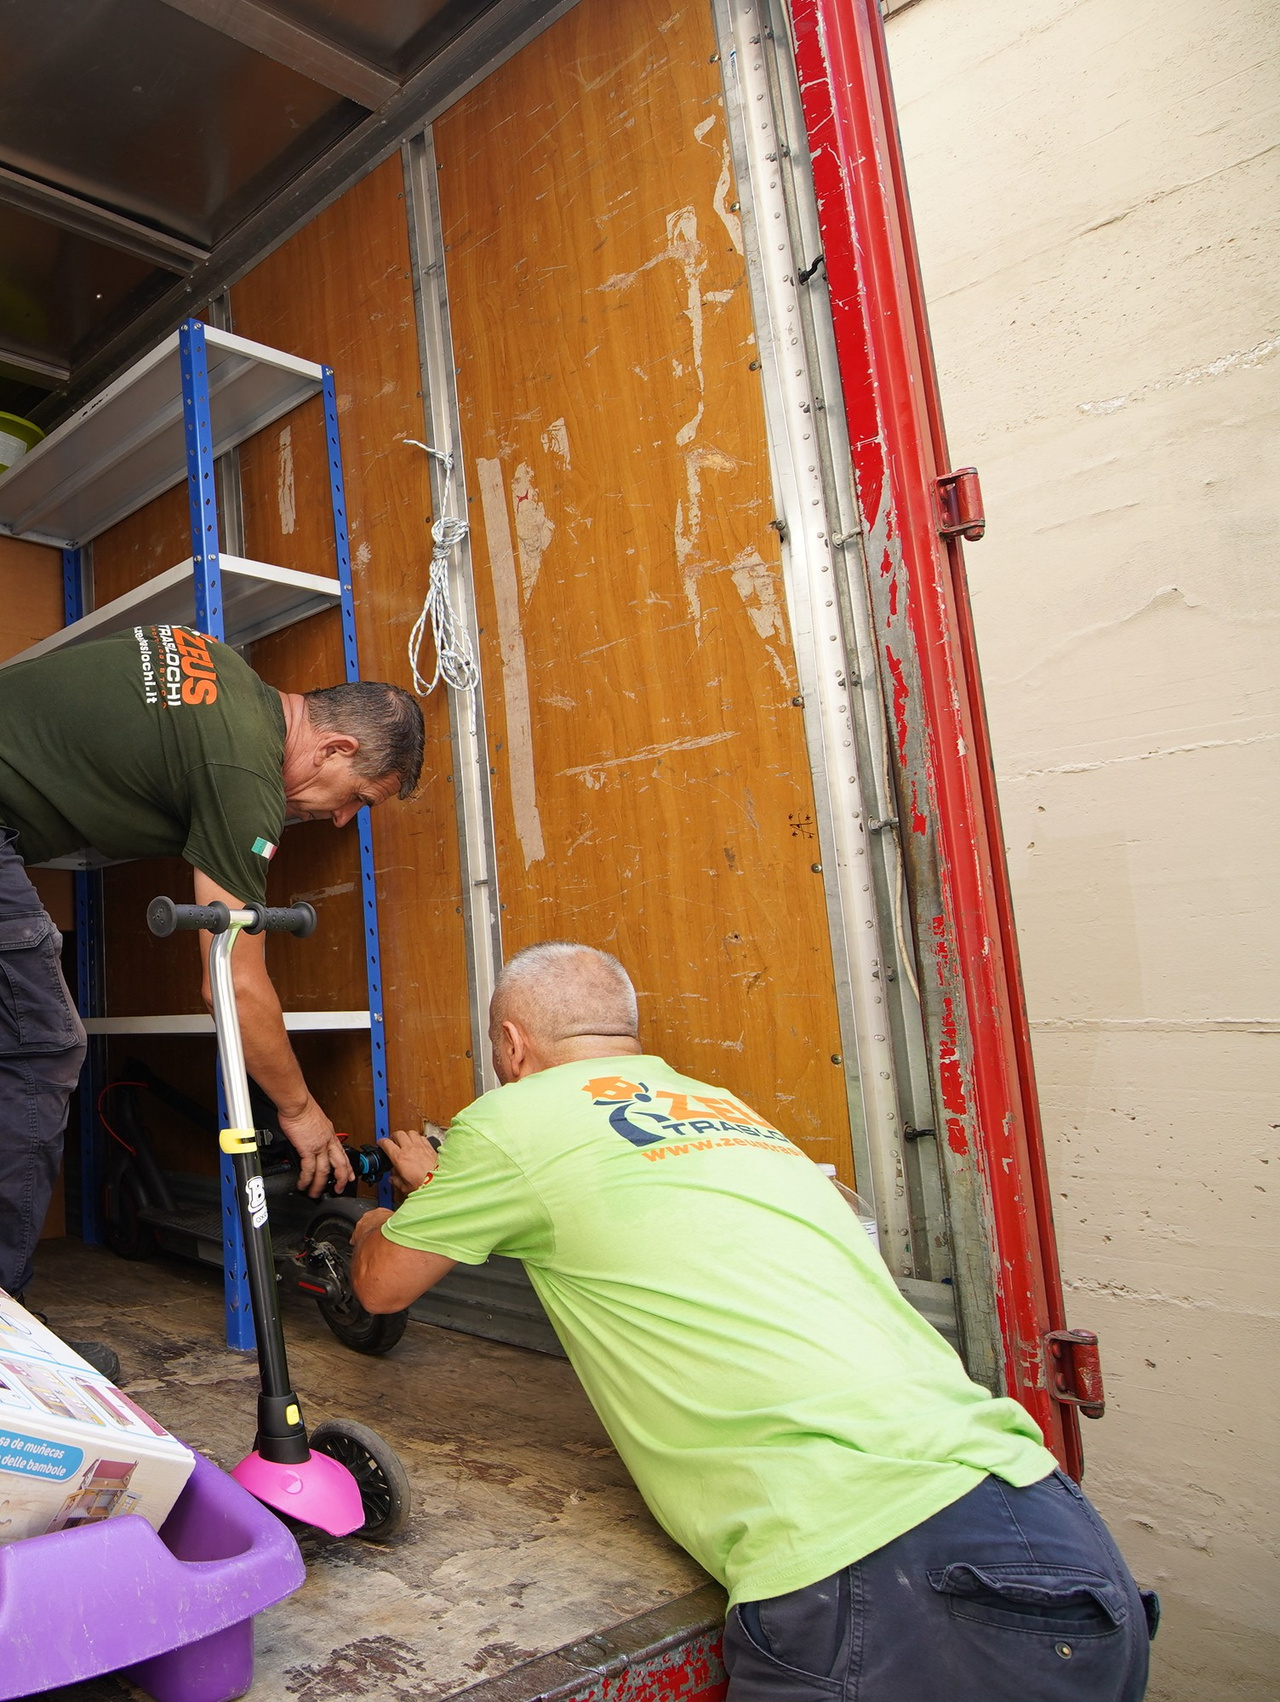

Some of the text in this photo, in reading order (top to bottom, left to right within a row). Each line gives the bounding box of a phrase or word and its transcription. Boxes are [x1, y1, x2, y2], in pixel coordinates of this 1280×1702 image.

[172, 628, 218, 705] ZEUS
[655, 1090, 776, 1131] ZEU
[661, 1120, 789, 1143] TRASLO
[10, 1438, 24, 1450] de
[23, 1442, 65, 1459] muñecas
[1, 1454, 27, 1469] delle
[26, 1459, 67, 1477] bambole
